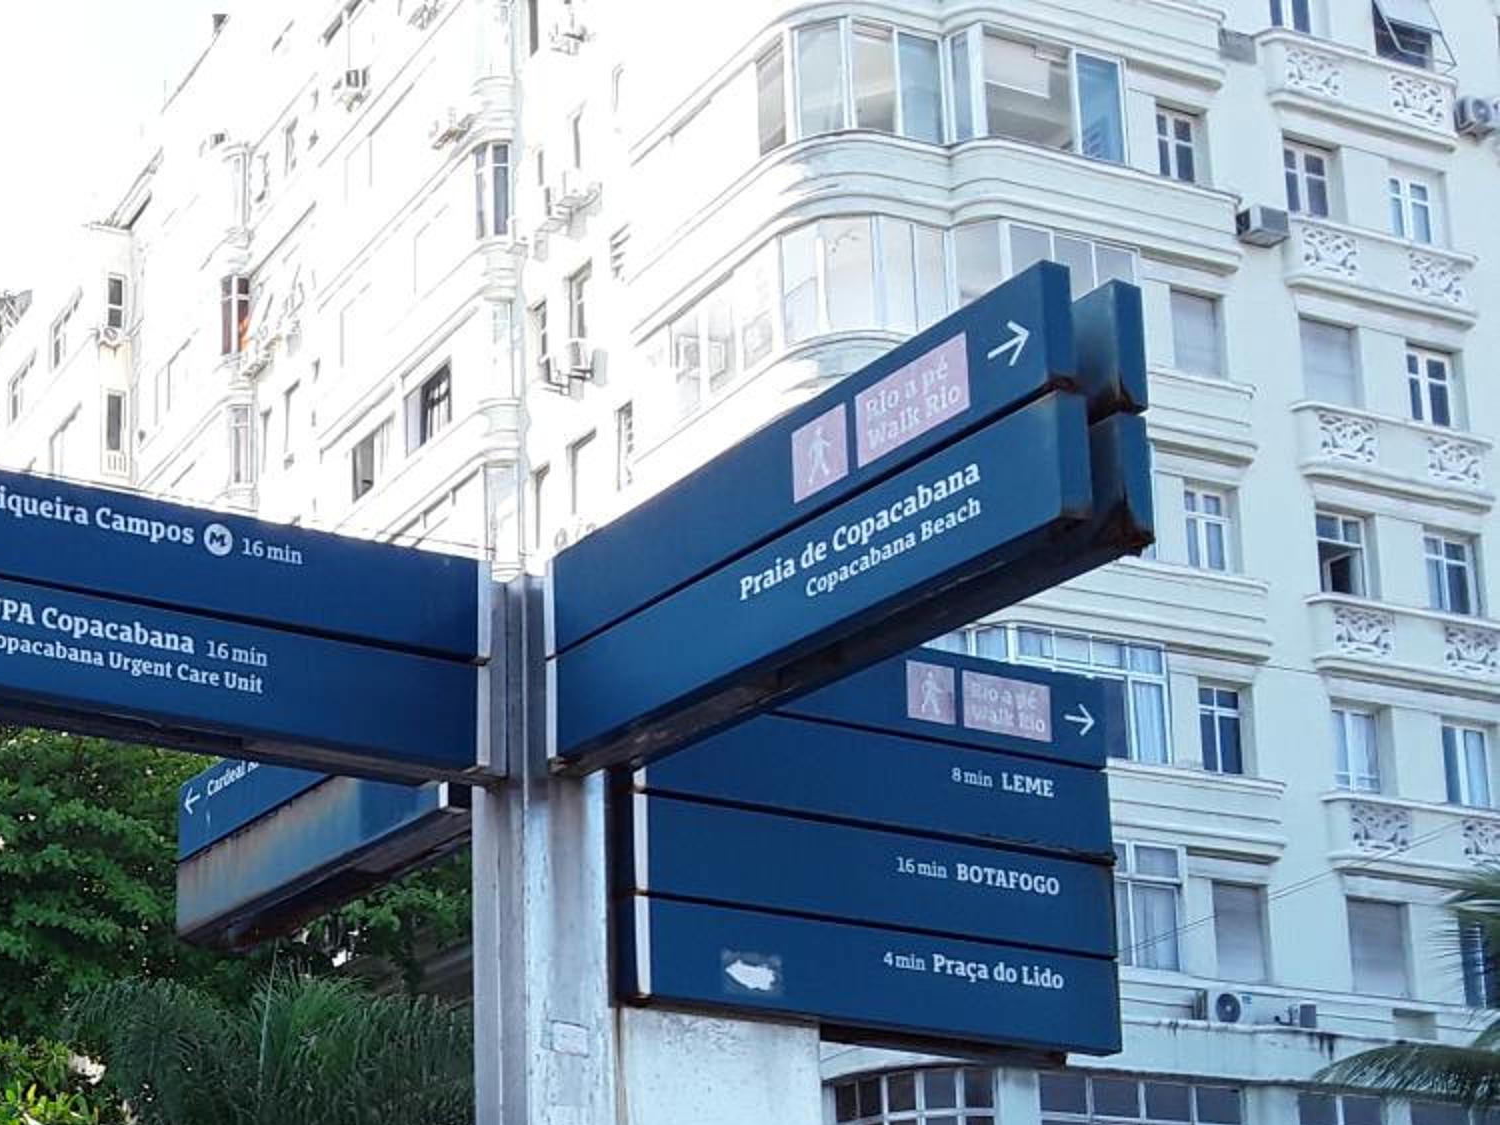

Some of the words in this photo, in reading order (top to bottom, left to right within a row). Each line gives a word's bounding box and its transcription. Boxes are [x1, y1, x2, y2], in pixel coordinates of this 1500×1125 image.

[866, 389, 899, 413] Rio
[868, 405, 920, 450] Walk
[926, 384, 961, 417] Rio
[95, 507, 195, 544] Campos
[242, 538, 264, 557] 16
[267, 544, 303, 565] min
[740, 557, 796, 601] Praia
[801, 541, 827, 568] de
[833, 463, 980, 552] Copacabana
[805, 531, 917, 597] Copacabana
[921, 497, 981, 541] Beach
[41, 606, 195, 654] Copacabana
[206, 640, 229, 660] 16
[232, 647, 268, 667] min
[109, 651, 173, 678] Urgent
[177, 664, 220, 686] Care
[224, 671, 263, 694] Unit
[951, 767, 962, 782] 8
[963, 769, 993, 788] min
[1001, 771, 1054, 797] LEME
[896, 856, 916, 874] 16
[917, 860, 948, 879] min
[956, 863, 1060, 896] BOTAFOGO
[883, 951, 893, 966] 4
[895, 953, 926, 971] min
[932, 953, 989, 983] Praça
[993, 962, 1018, 983] do
[1021, 964, 1065, 989] Lido
